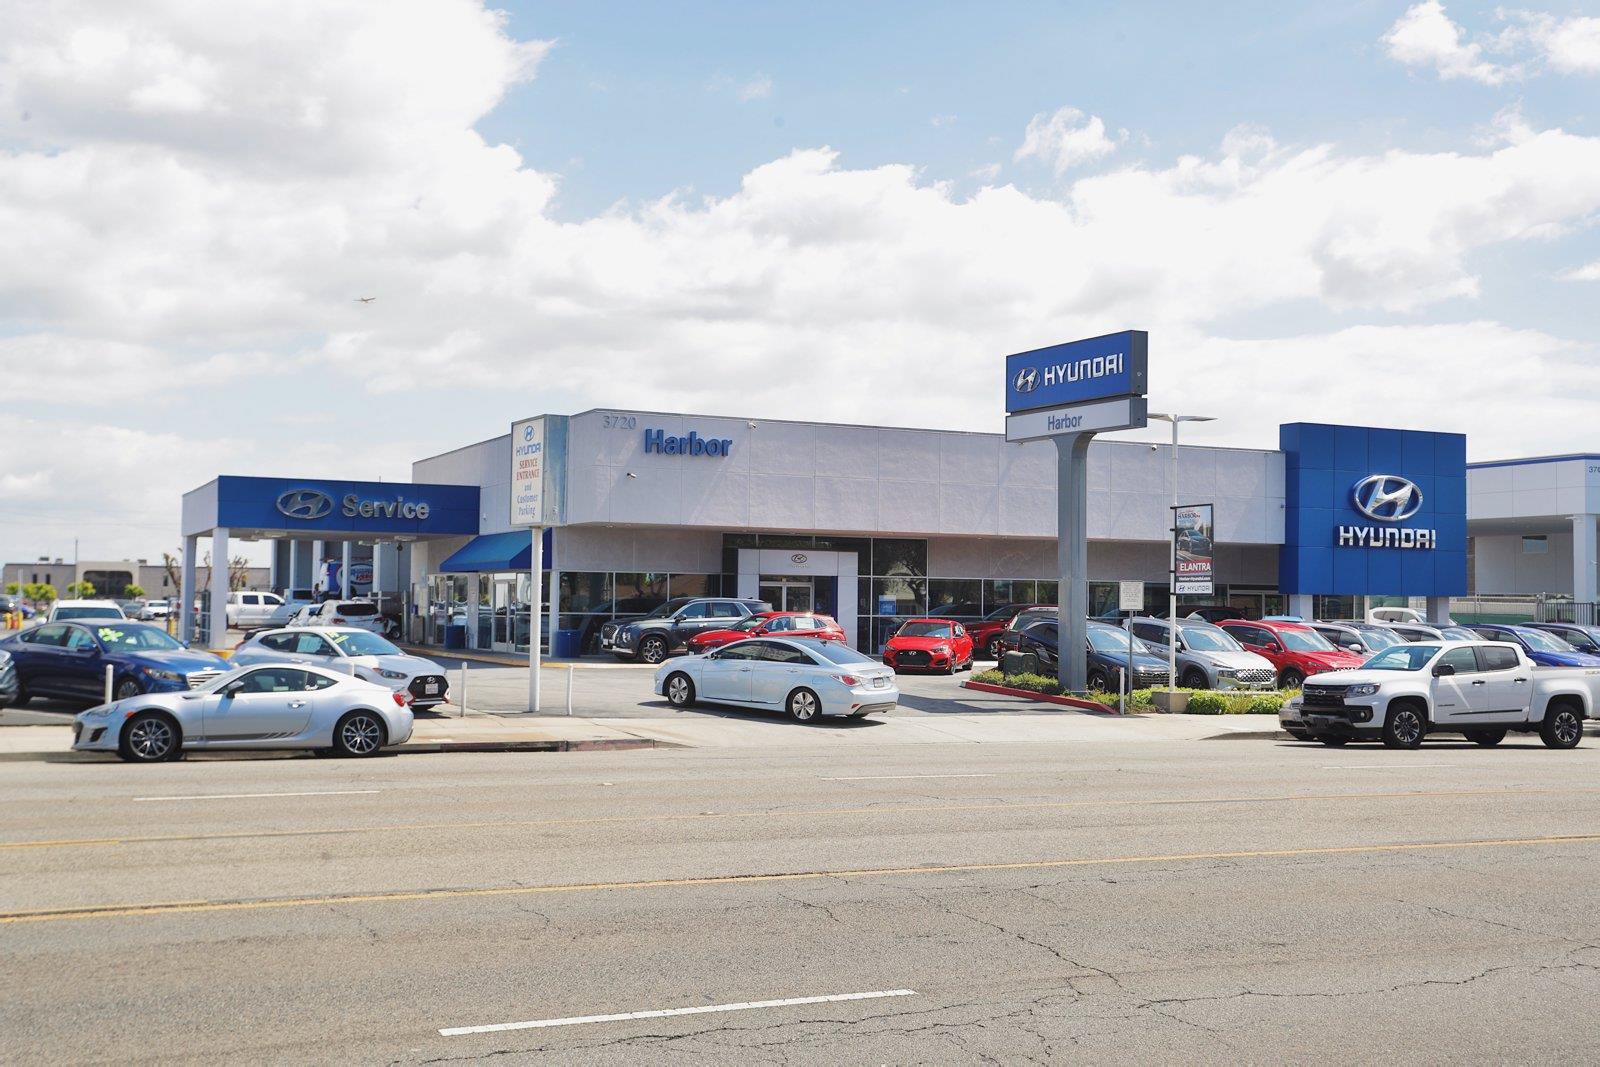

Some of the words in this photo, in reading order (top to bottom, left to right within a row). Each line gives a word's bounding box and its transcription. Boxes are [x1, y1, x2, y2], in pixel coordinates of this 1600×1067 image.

[1044, 353, 1123, 386] HYUNDAI
[602, 414, 636, 430] 3720
[1047, 413, 1082, 431] Harbor
[515, 441, 542, 457] HYUNDAI
[644, 428, 733, 457] Harbor
[519, 458, 538, 470] SERVICE
[516, 469, 540, 481] ENTRANCE
[342, 493, 430, 520] Service
[517, 494, 538, 504] Customer
[518, 504, 536, 518] Parking
[1339, 525, 1437, 549] HYUNDAI
[1180, 562, 1211, 571] ELANTRA
